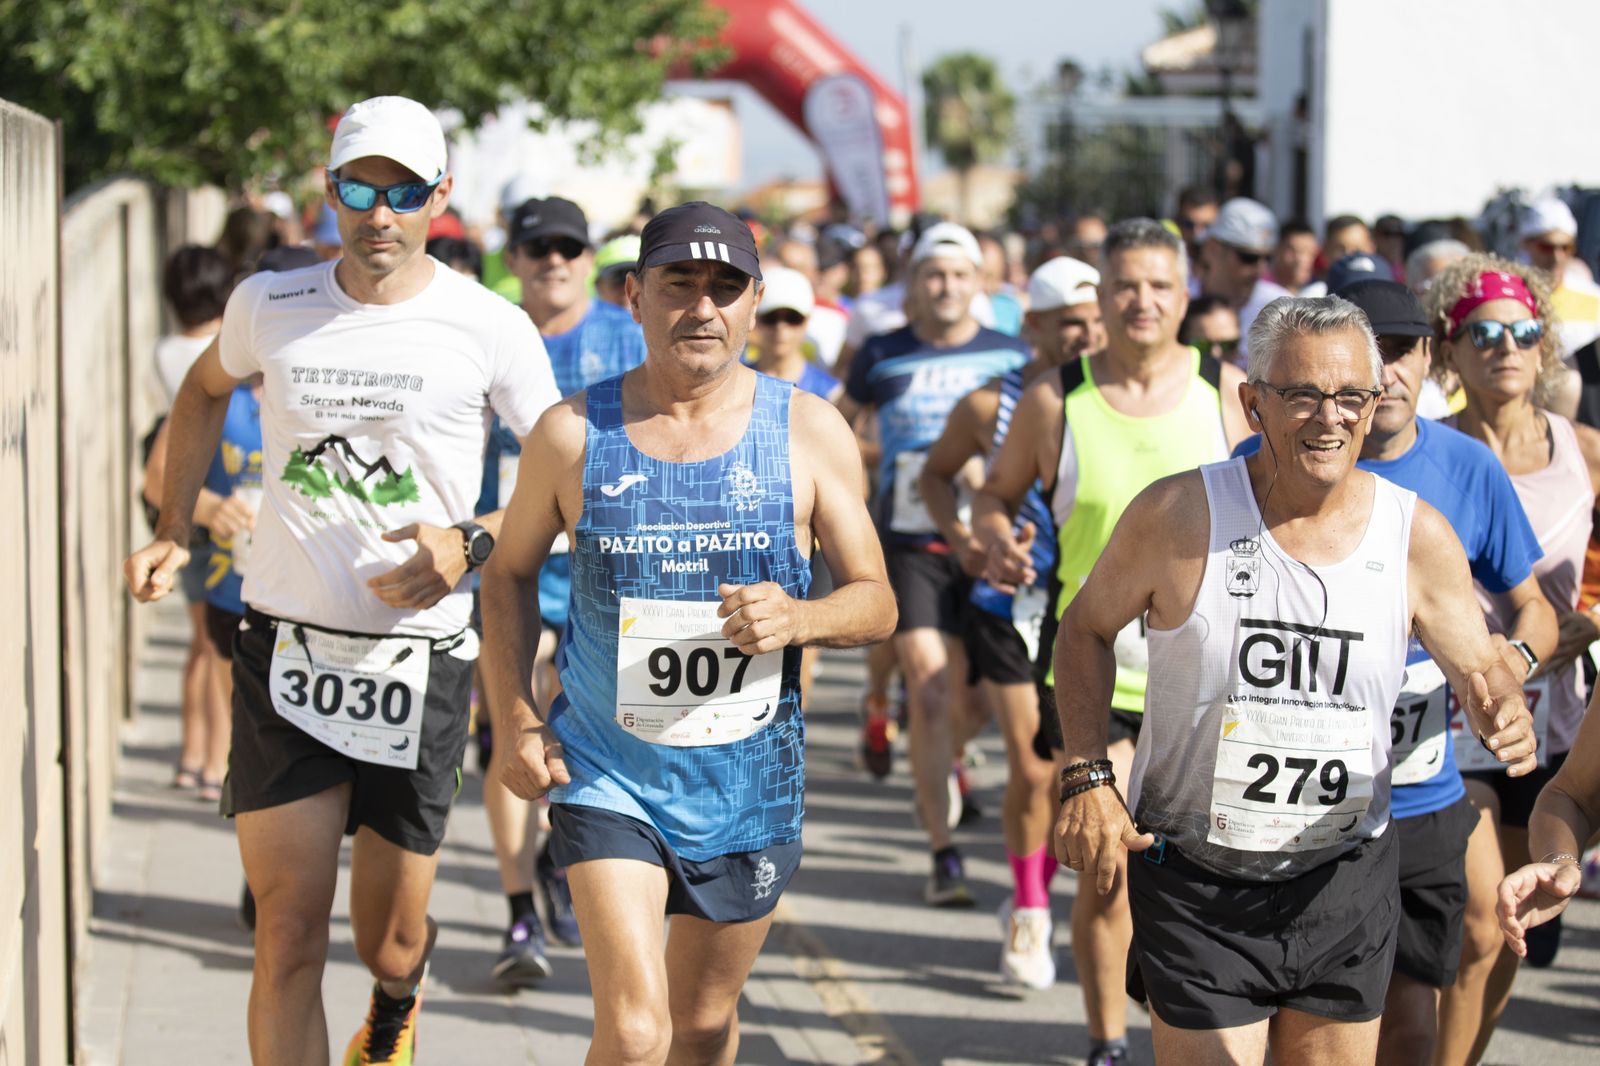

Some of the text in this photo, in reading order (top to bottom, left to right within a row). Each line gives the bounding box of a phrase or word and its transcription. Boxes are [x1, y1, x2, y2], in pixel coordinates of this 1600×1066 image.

[694, 225, 721, 234] adidas
[269, 288, 303, 301] luanvi
[291, 367, 424, 392] TRYSTRONG
[300, 394, 404, 412] Sierra Nevada
[637, 521, 731, 531] Asociación Deportiva
[600, 532, 770, 554] PAZITO a PAZITO
[662, 558, 709, 573] Motril
[648, 646, 755, 697] 907
[279, 669, 412, 726] 3030
[1249, 694, 1280, 705] integral
[1281, 696, 1324, 709] innovación
[1242, 753, 1349, 806] 279
